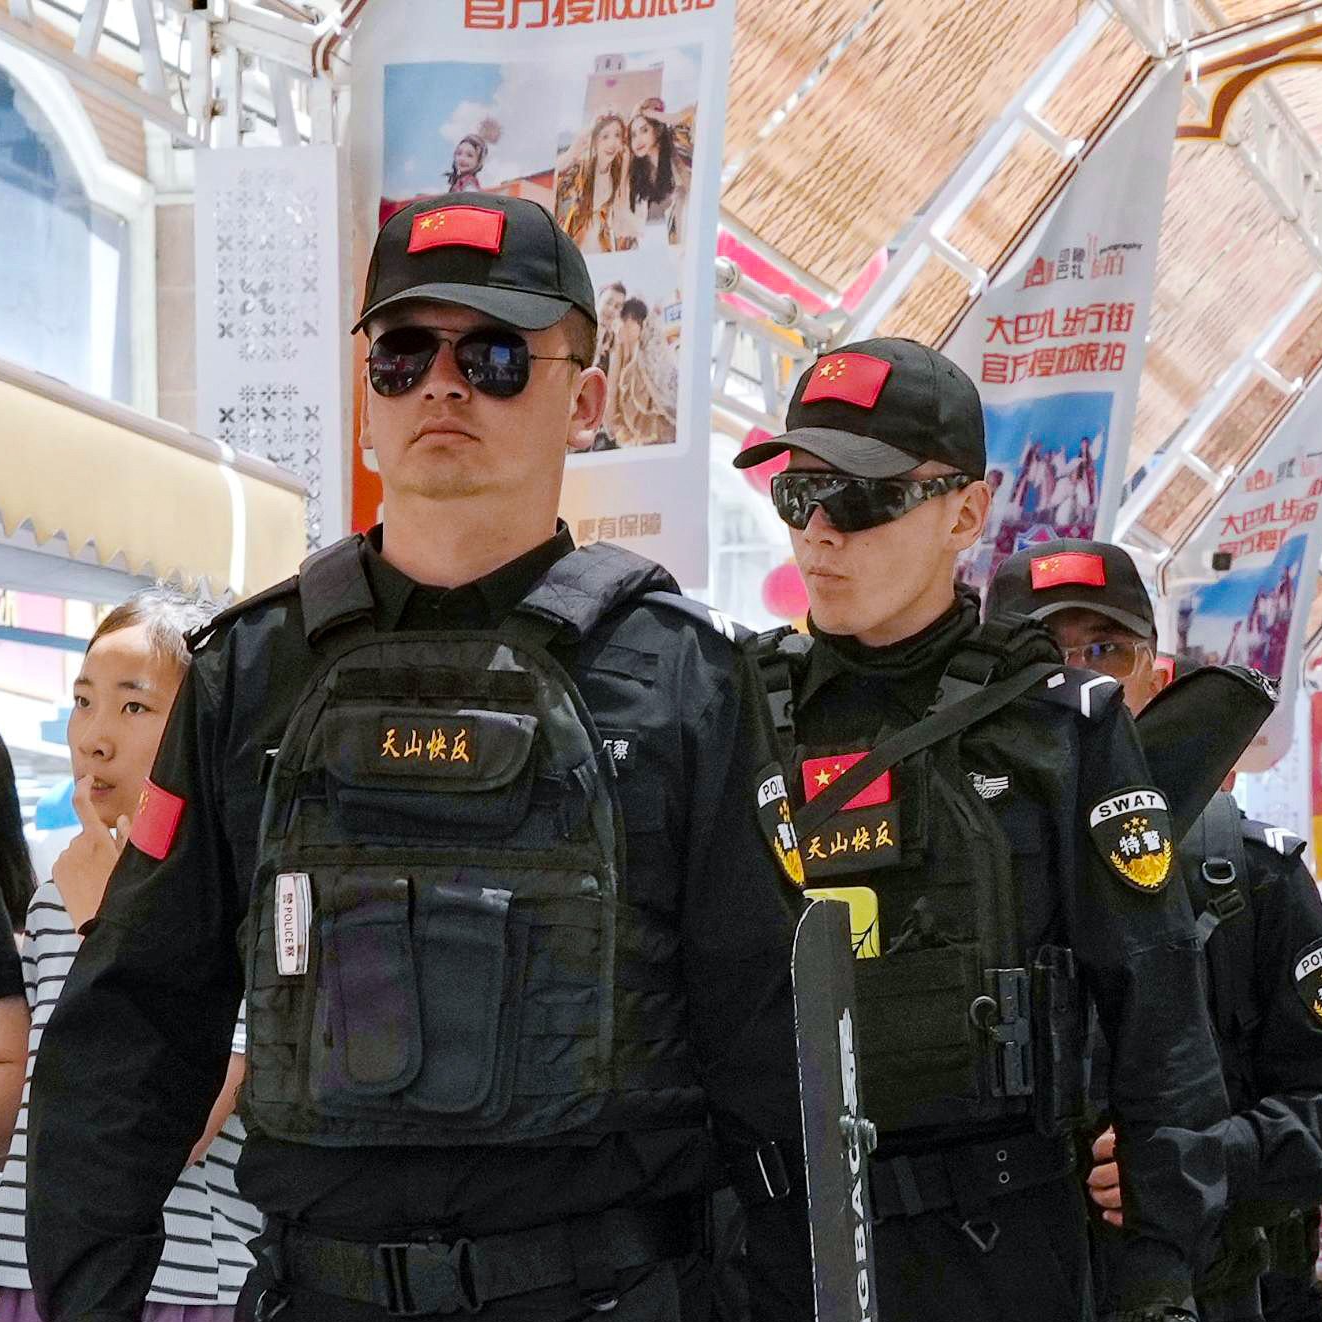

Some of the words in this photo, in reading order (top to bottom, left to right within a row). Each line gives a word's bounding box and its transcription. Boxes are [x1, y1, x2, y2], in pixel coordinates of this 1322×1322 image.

[986, 302, 1135, 345] 大巴扎步行街
[981, 342, 1126, 384] 官方授权旅拍
[380, 729, 470, 763] 天山快反
[602, 739, 629, 760] 察
[1098, 794, 1156, 818] SWAT
[806, 820, 894, 861] 天山快反
[1119, 829, 1161, 856] 特警
[284, 907, 294, 944] POLICE
